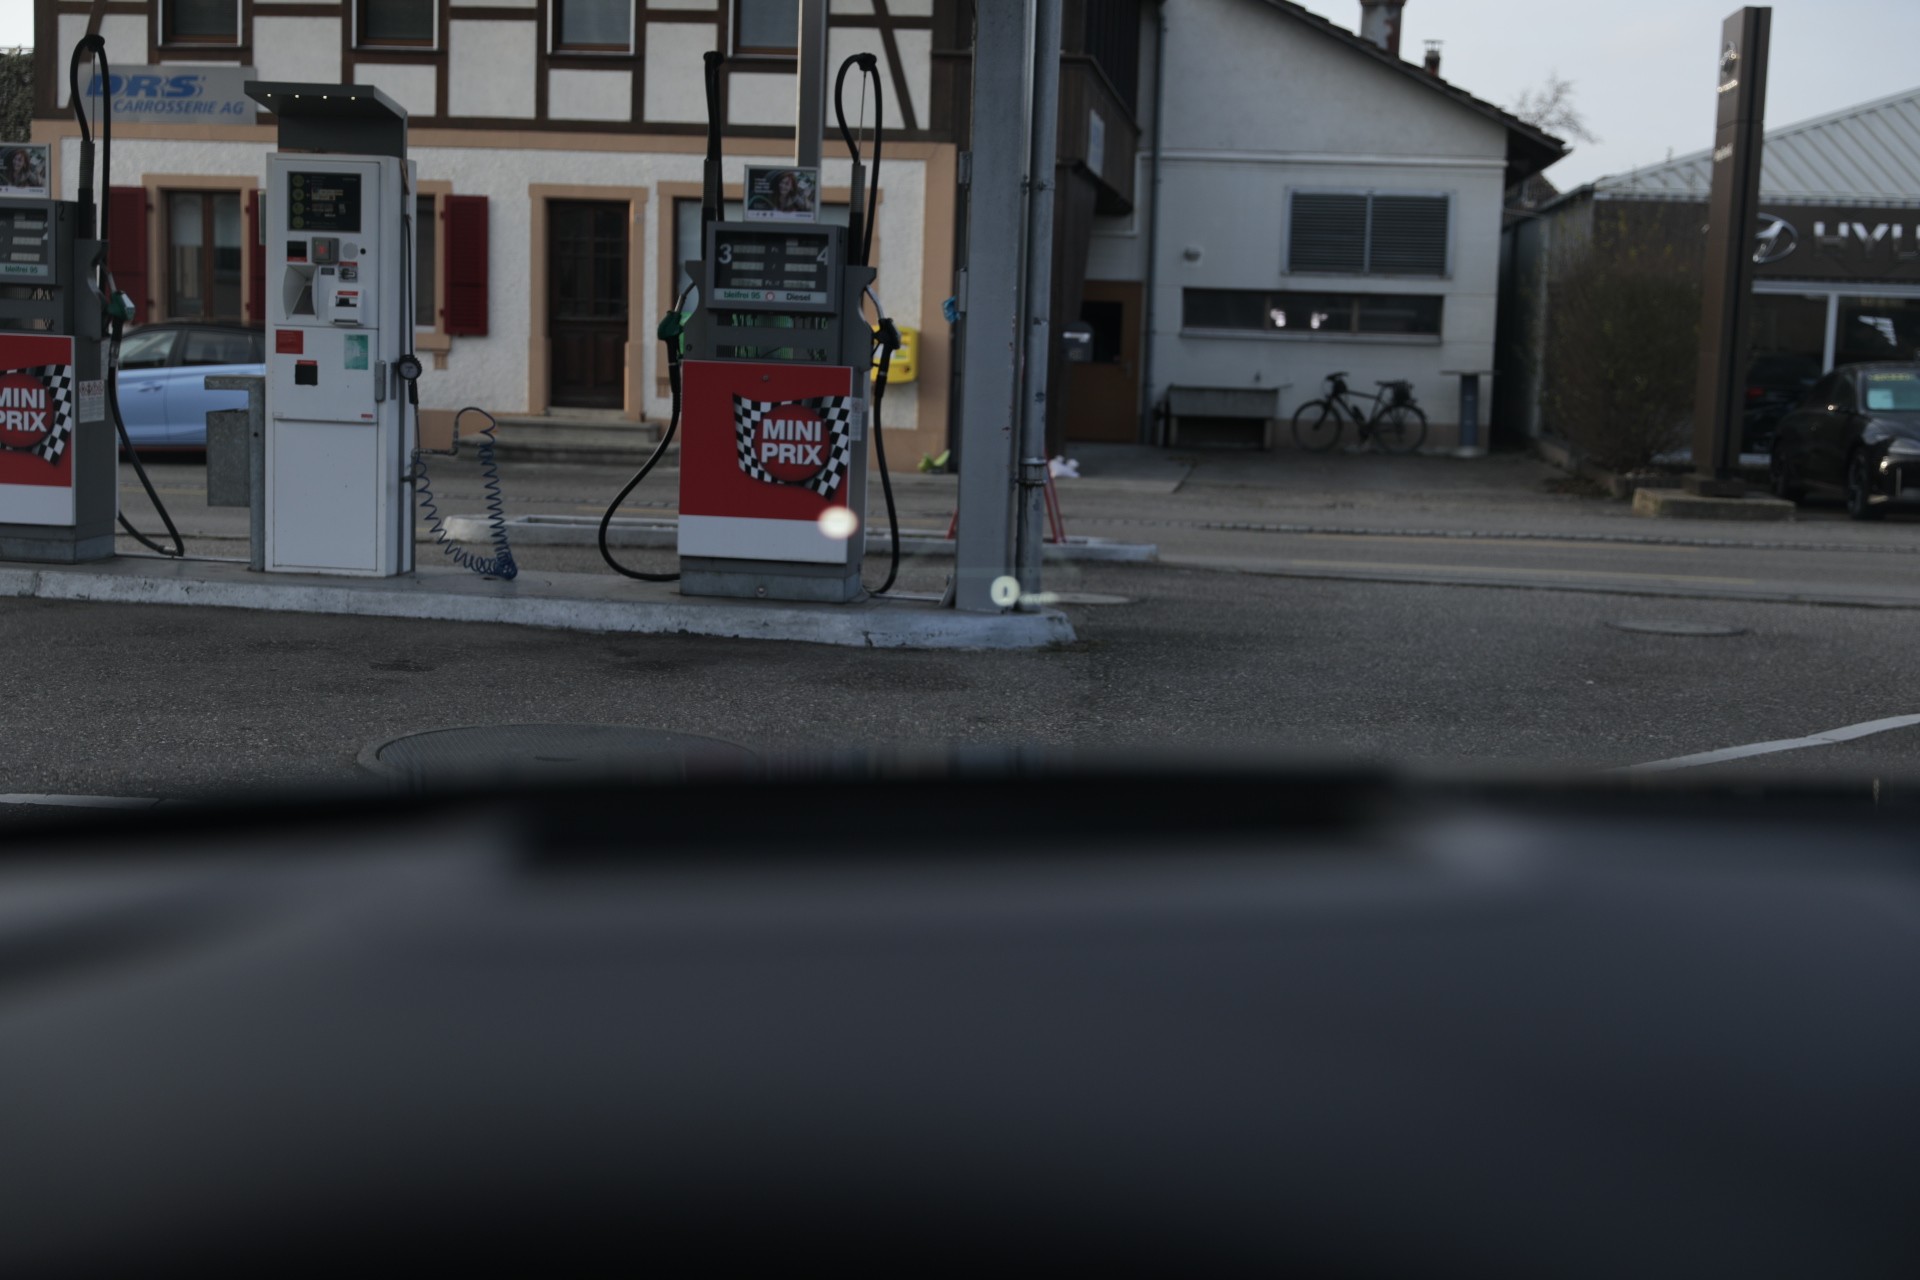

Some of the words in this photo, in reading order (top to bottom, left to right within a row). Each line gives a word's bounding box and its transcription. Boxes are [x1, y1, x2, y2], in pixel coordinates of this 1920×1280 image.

[86, 74, 203, 97] DRS
[113, 100, 215, 115] CARROSSERIE
[220, 102, 244, 115] AG
[718, 243, 732, 264] 3
[816, 246, 828, 265] 4
[4, 265, 28, 273] bleifrei
[30, 266, 38, 274] 95
[723, 290, 749, 299] bleifrei
[750, 291, 761, 300] 95
[786, 292, 811, 301] Diesel
[762, 419, 822, 442] MINI
[761, 442, 823, 466] PRIX
